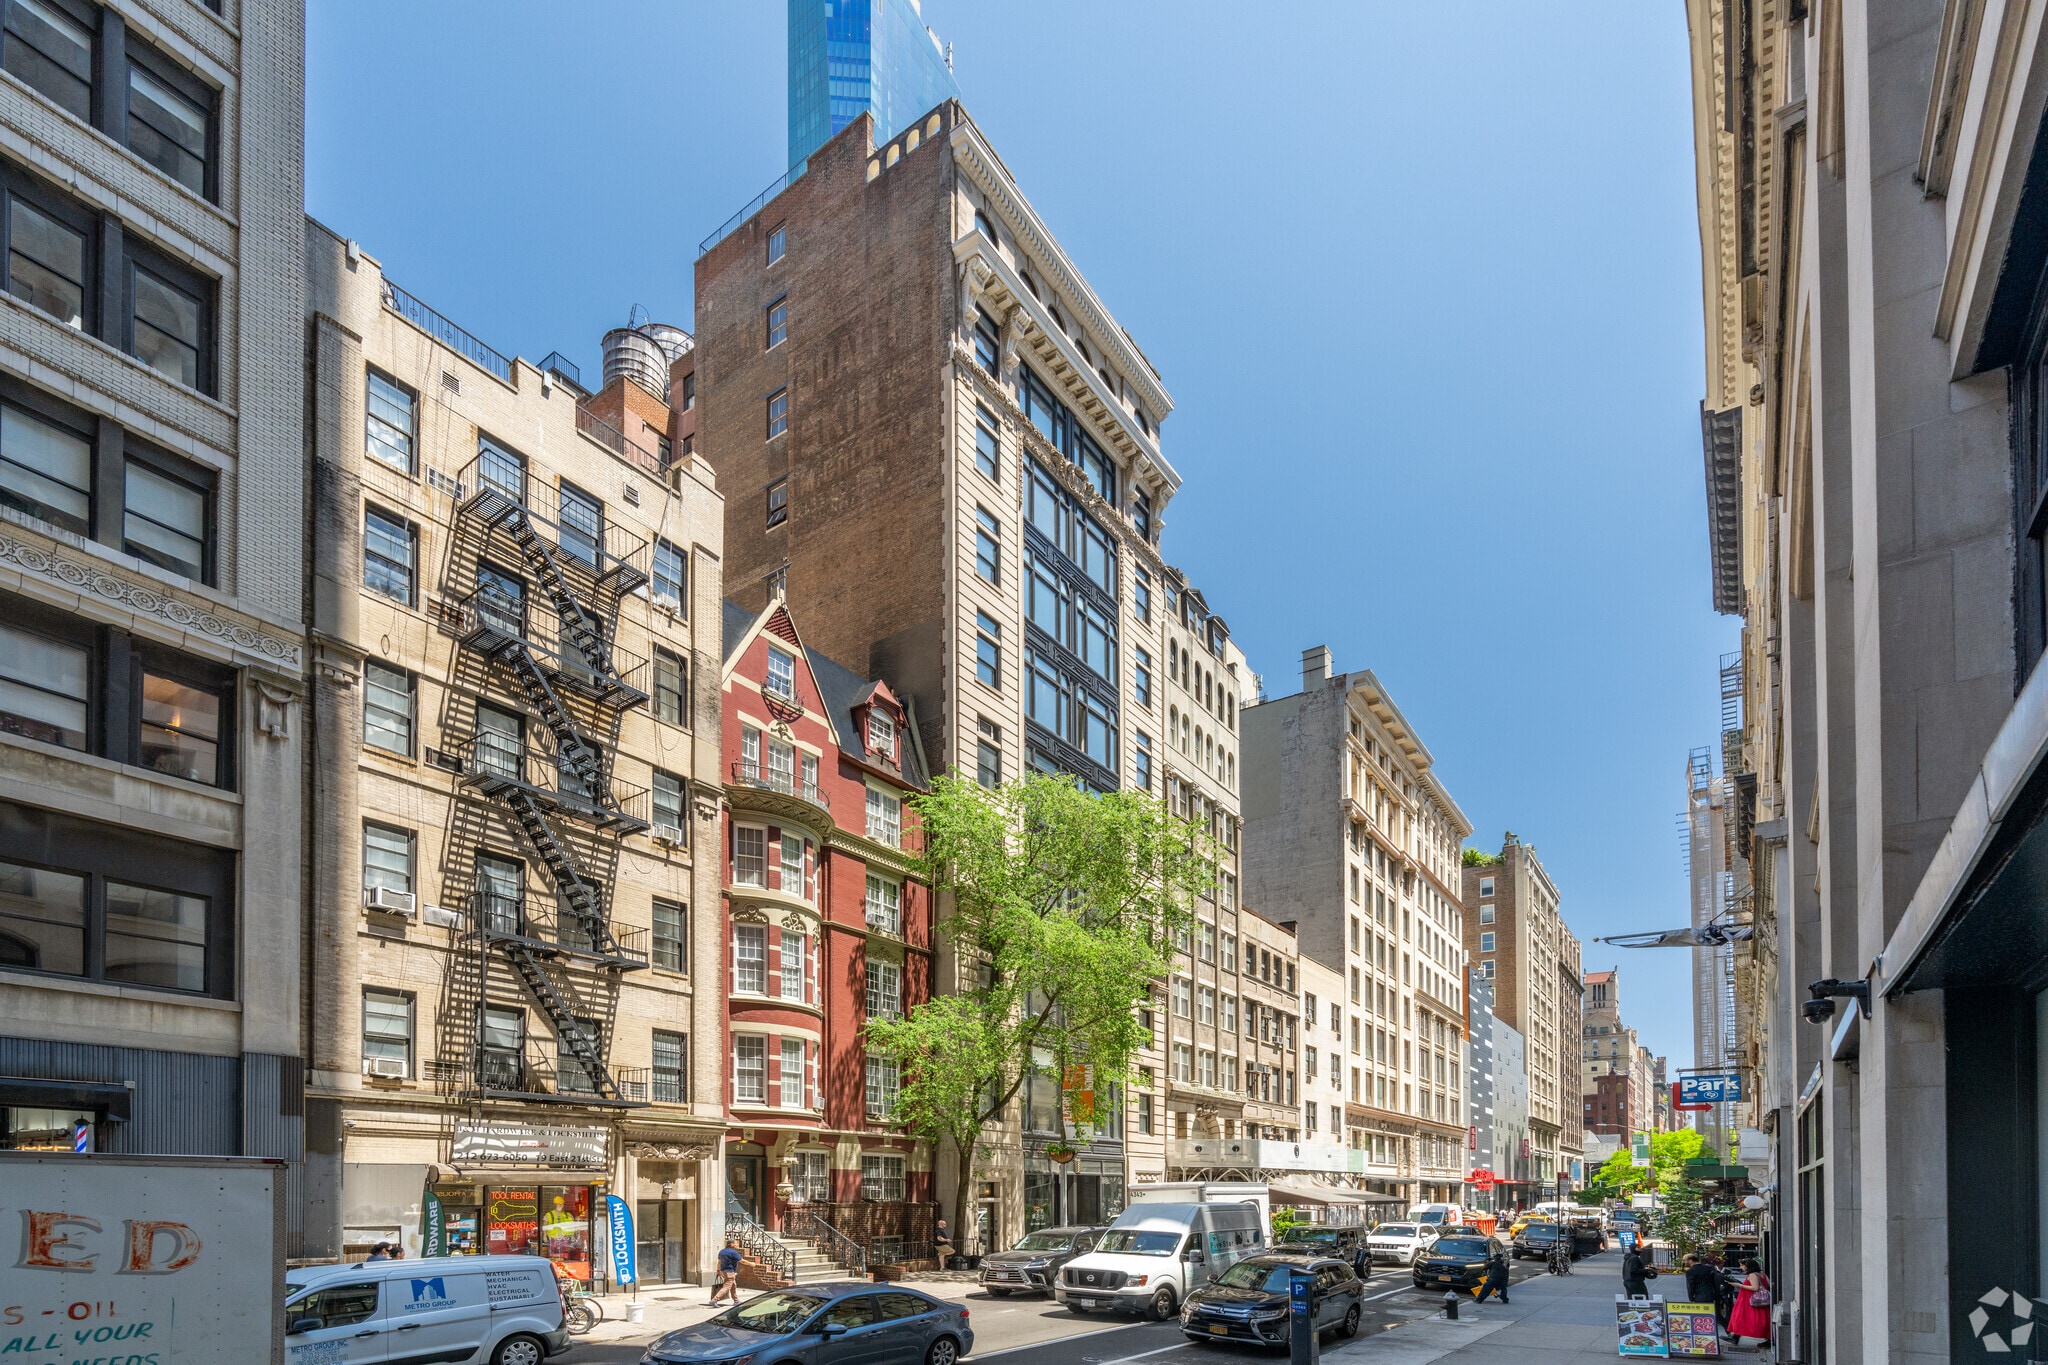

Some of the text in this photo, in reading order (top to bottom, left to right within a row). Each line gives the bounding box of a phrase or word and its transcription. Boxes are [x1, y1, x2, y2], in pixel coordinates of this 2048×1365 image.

[1682, 1077, 1740, 1092] Park
[548, 1130, 604, 1138] LOCKSMITHS
[456, 1152, 477, 1160] 212
[480, 1153, 528, 1161] 673-6050
[536, 1154, 547, 1162] 19
[549, 1154, 569, 1162] East
[570, 1155, 590, 1163] 21st
[491, 1191, 536, 1200] TOOL RENTAL
[426, 1201, 439, 1257] RDWARE
[491, 1221, 537, 1230] LOCKSMITHS
[613, 1202, 629, 1266] LOCKSMITH
[0, 1207, 205, 1276] ED
[488, 1288, 530, 1296] ELECTRICAL
[1295, 1284, 1304, 1295] P
[489, 1293, 536, 1302] SUSTAINABLE
[405, 1303, 431, 1311] METRO
[431, 1300, 457, 1308] GROUP
[0, 1322, 154, 1354] ALL YOUR
[291, 1344, 312, 1353] METRO
